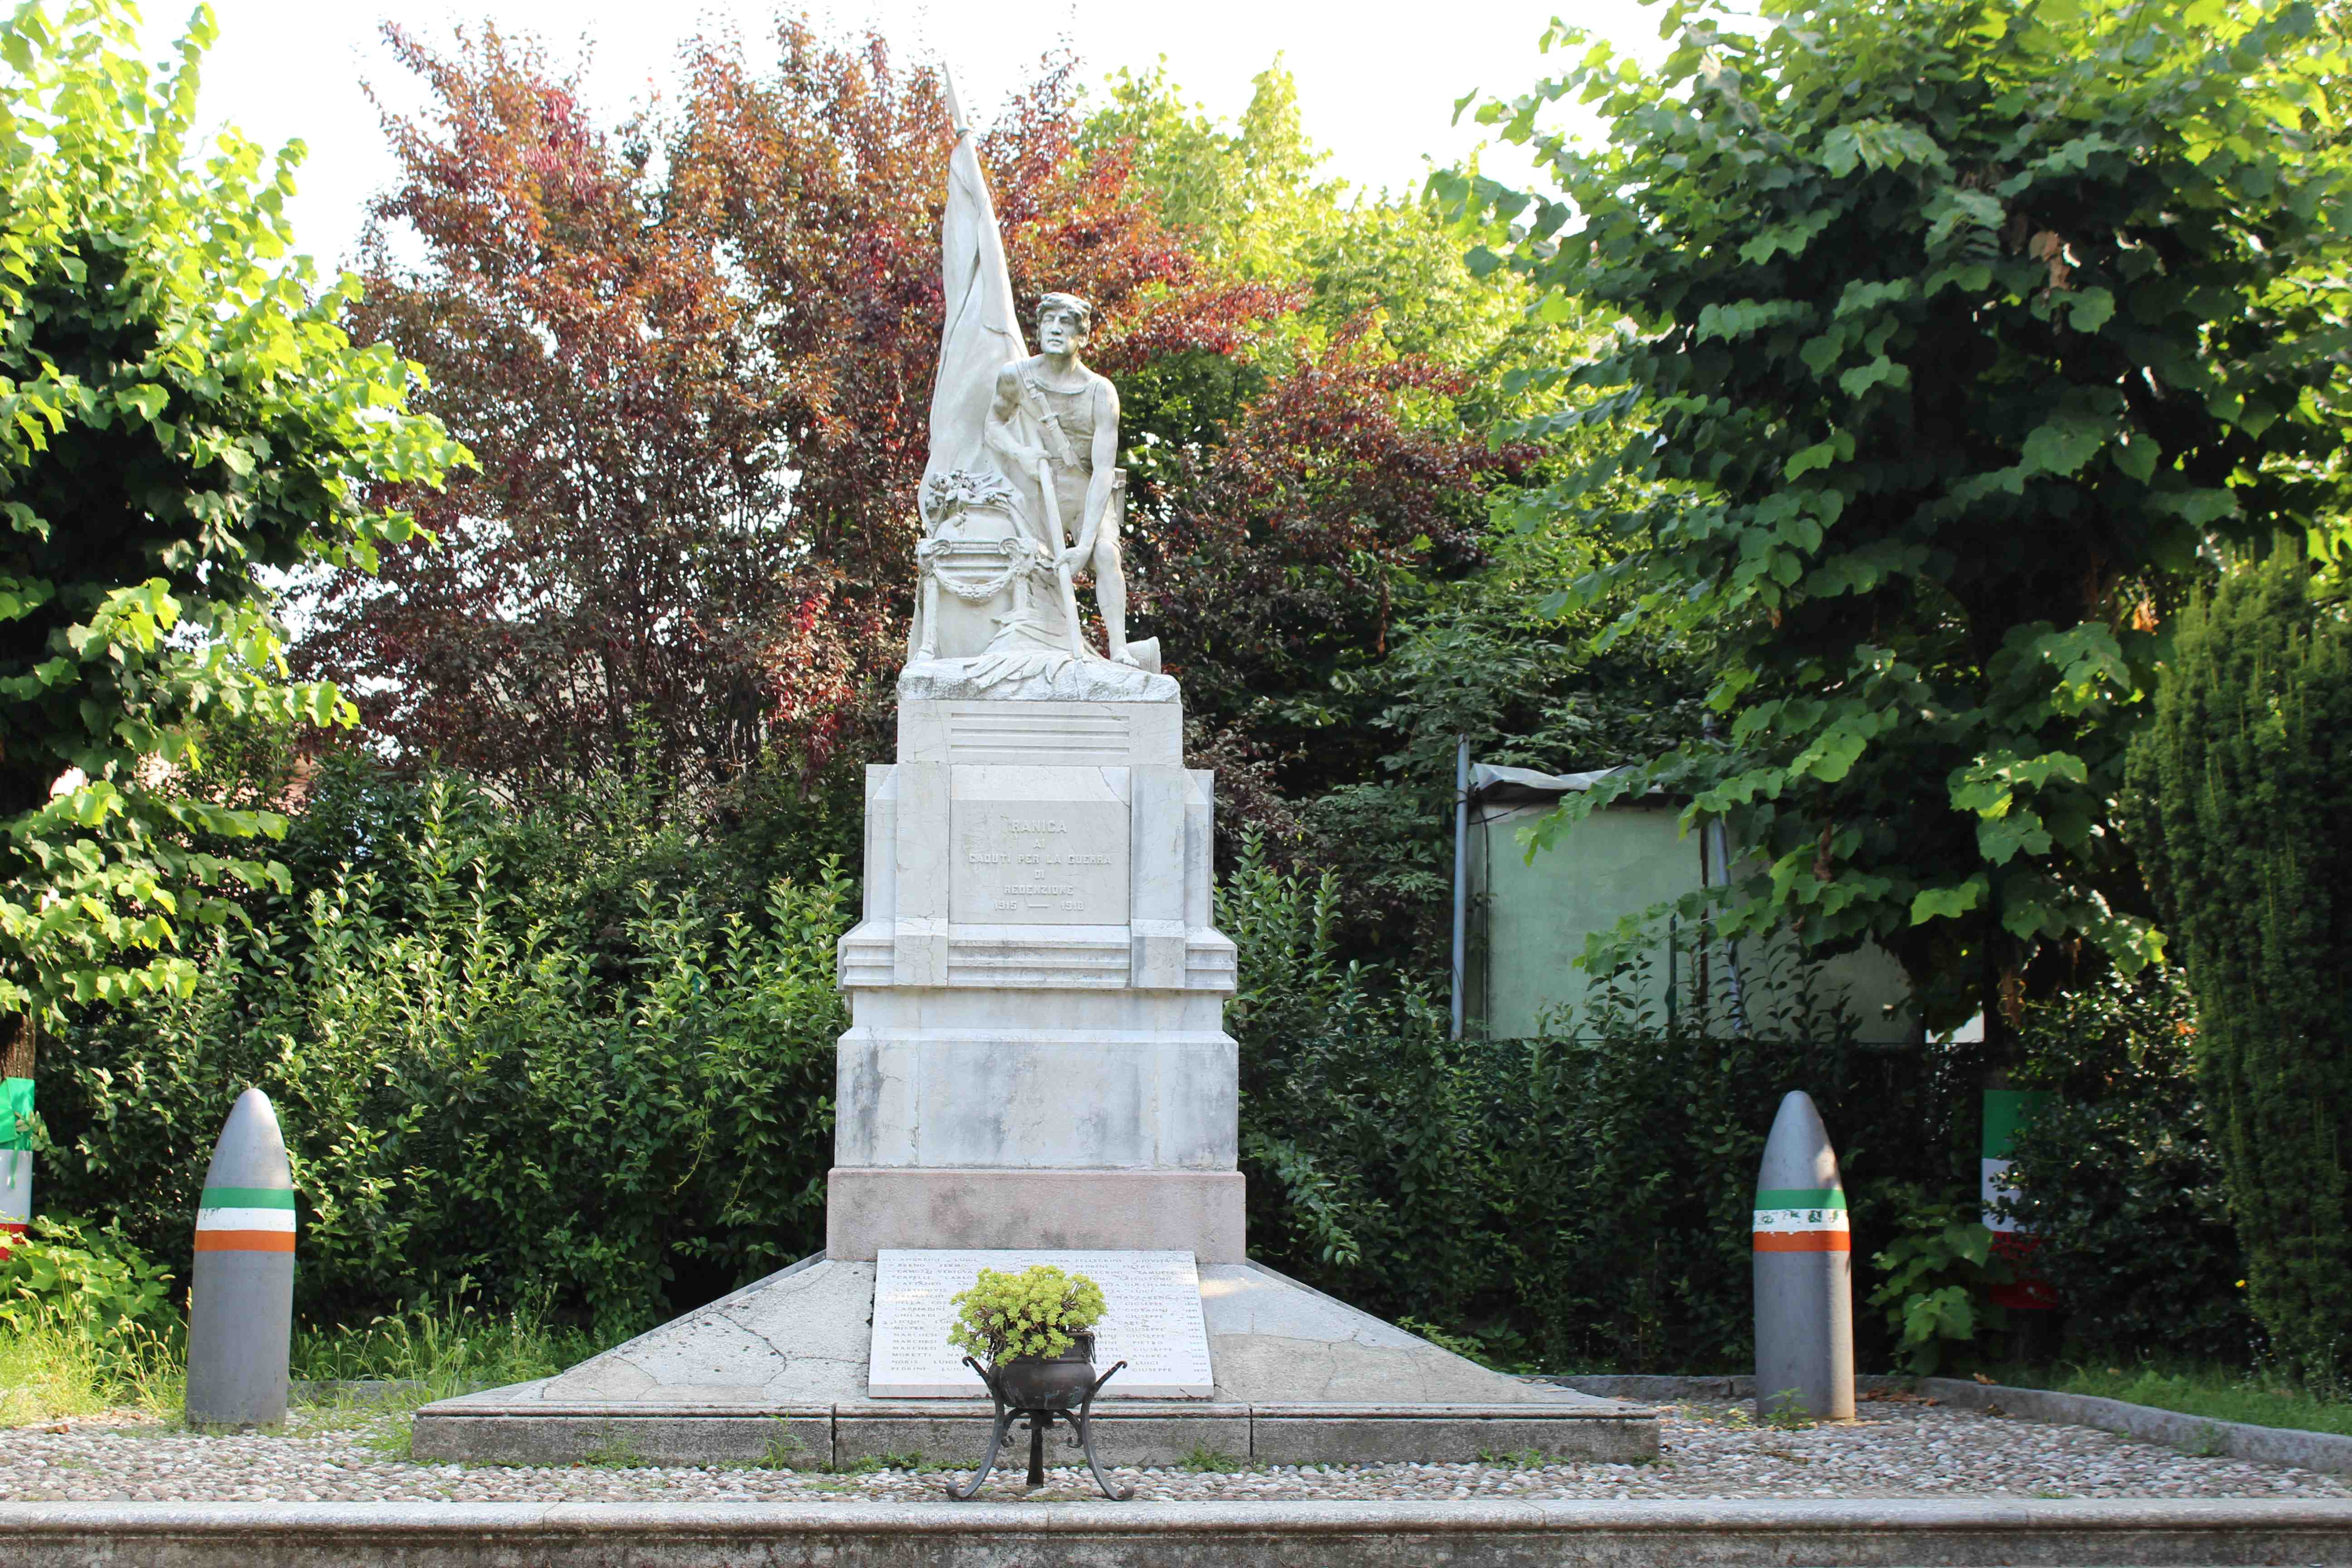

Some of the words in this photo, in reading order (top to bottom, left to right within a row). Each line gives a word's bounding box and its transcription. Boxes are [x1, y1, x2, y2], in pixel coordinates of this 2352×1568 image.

[1010, 820, 1067, 833] RANICA
[1033, 839, 1045, 849] AI
[969, 853, 1011, 864] CADUTI
[1018, 854, 1039, 864] PER
[1047, 854, 1061, 864] LA
[1068, 854, 1111, 865] GUERRA
[1034, 870, 1045, 880] DI
[1004, 885, 1075, 895] REDENZIONE
[994, 900, 1017, 911] 1915
[1060, 900, 1085, 911] 1918
